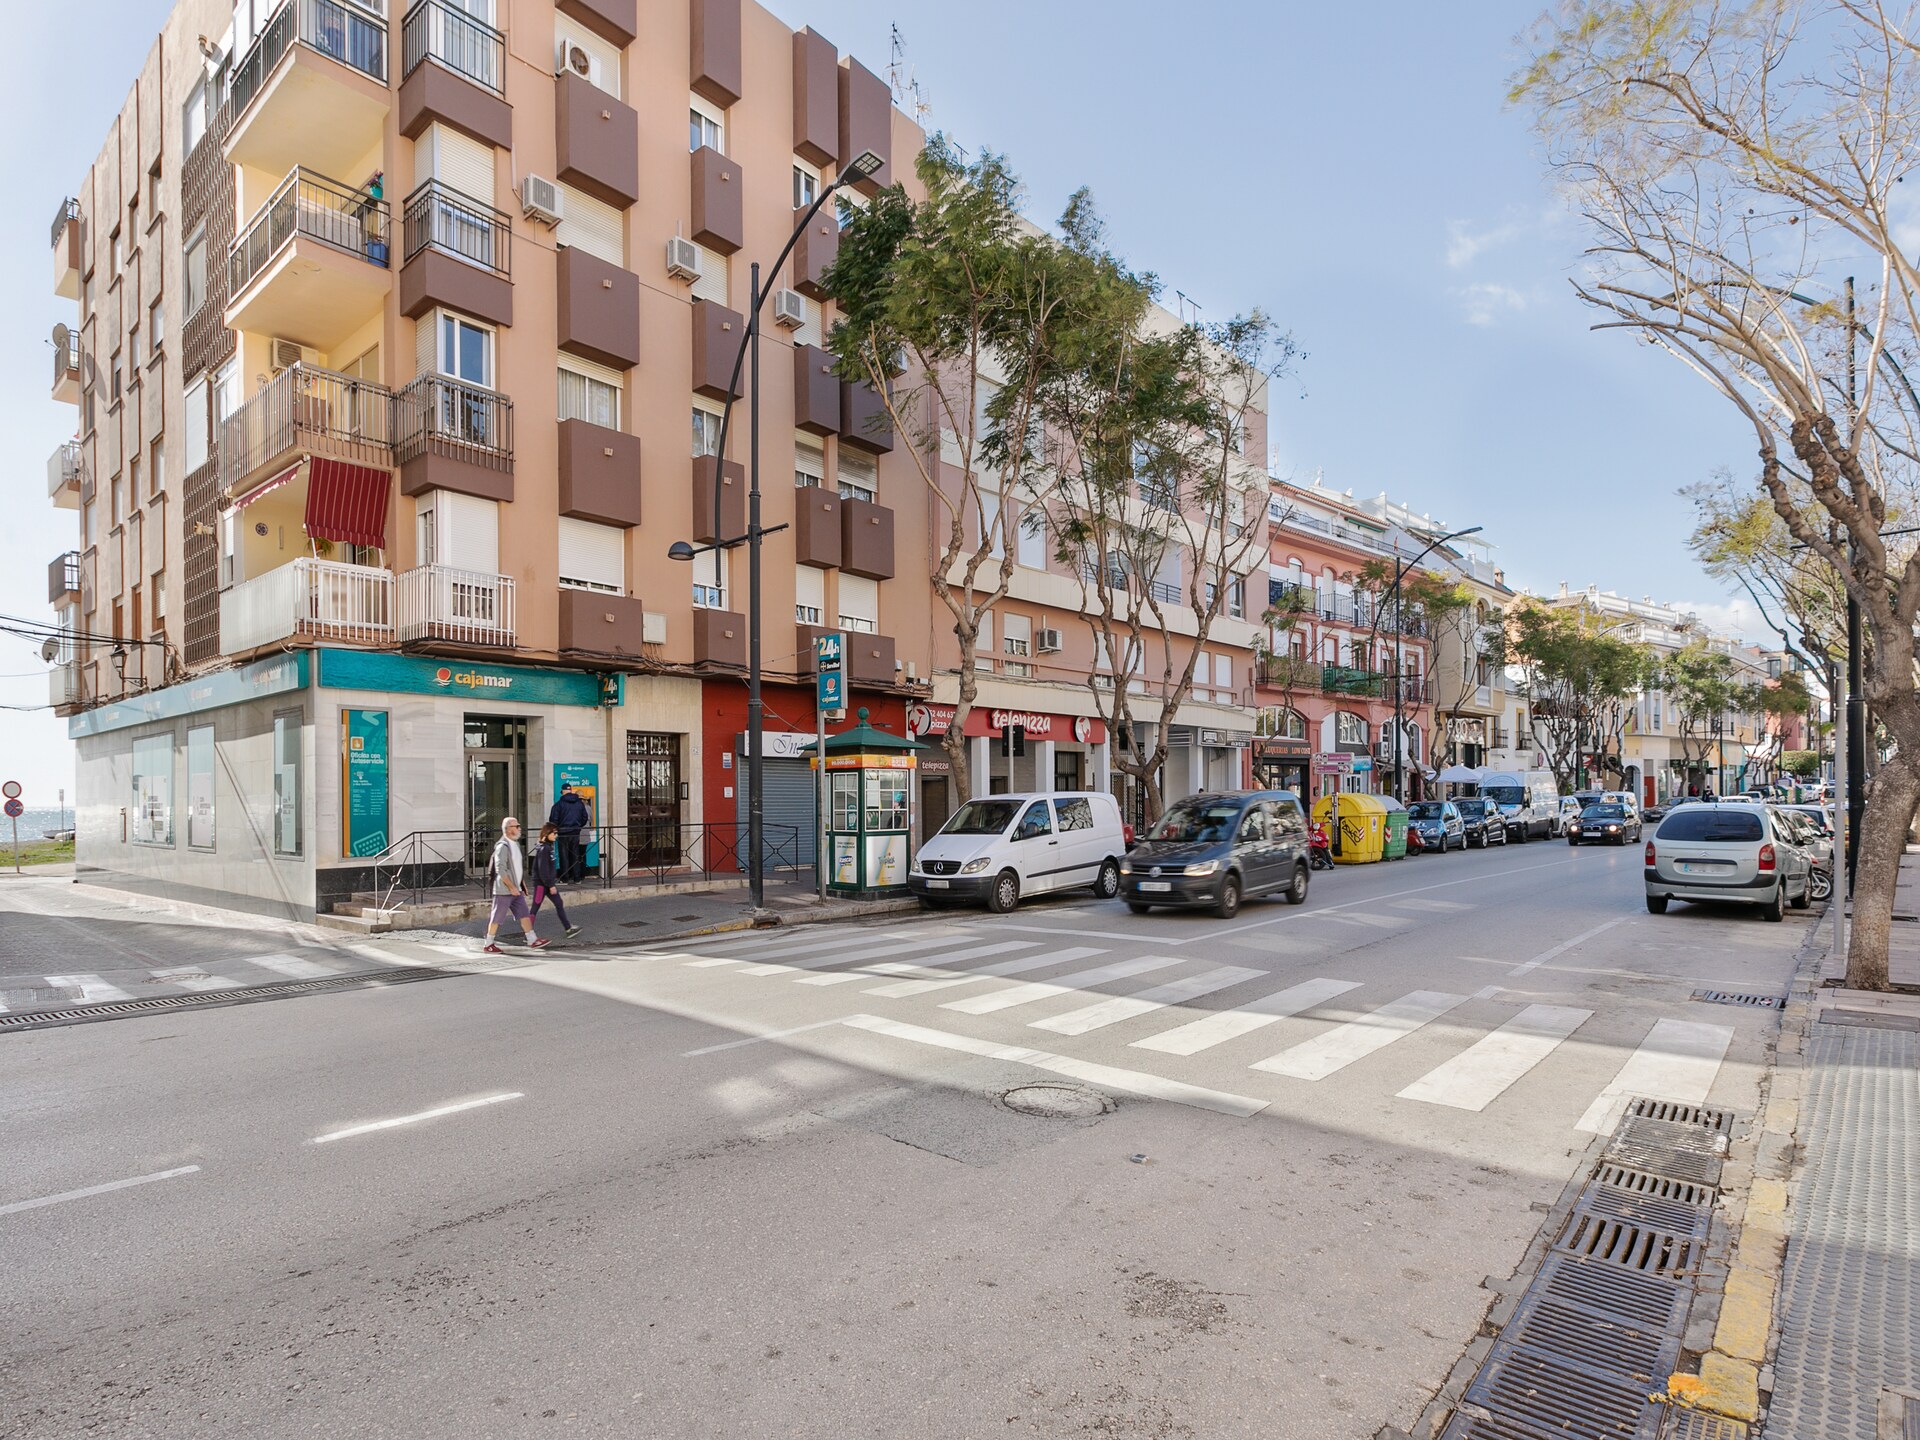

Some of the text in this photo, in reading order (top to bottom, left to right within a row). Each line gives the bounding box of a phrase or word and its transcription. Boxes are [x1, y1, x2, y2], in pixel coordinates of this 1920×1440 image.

[819, 637, 840, 659] 24h
[454, 670, 513, 689] cajamar
[603, 677, 618, 694] 24h
[937, 710, 947, 719] 404
[992, 709, 1051, 735] telepizza
[921, 761, 950, 772] telepizza
